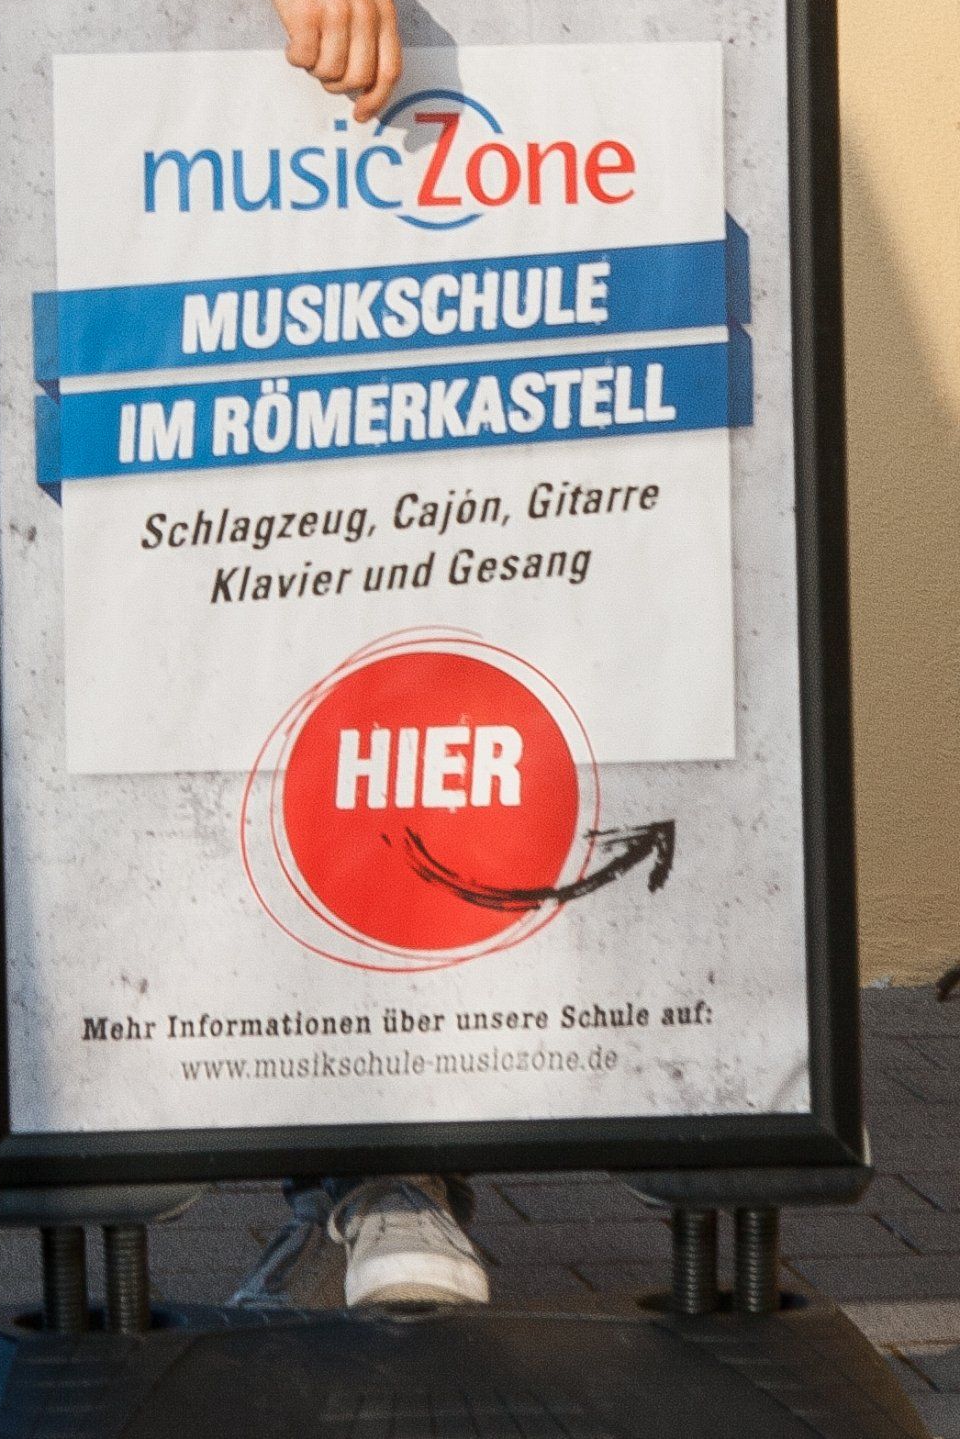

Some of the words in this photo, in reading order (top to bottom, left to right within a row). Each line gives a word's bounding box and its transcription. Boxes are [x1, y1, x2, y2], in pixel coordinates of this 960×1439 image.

[143, 113, 635, 213] musicZone
[181, 262, 612, 355] MUSIKSCHULE
[118, 398, 195, 464] IM
[212, 363, 677, 458] RÖMERKASTELL
[141, 499, 378, 550] Schlagzeug,
[392, 489, 511, 538] Cajón,
[527, 480, 661, 518] Gitarre
[210, 562, 352, 605] Klavier
[363, 552, 435, 593] und
[447, 545, 592, 585] Gesang
[335, 725, 523, 810] HIER
[82, 1016, 157, 1042] Mehr
[166, 1012, 372, 1039] Informationen
[382, 1010, 445, 1035] über
[456, 1010, 549, 1031] unsere
[560, 1003, 650, 1030] Schule
[661, 1001, 714, 1026] auf:
